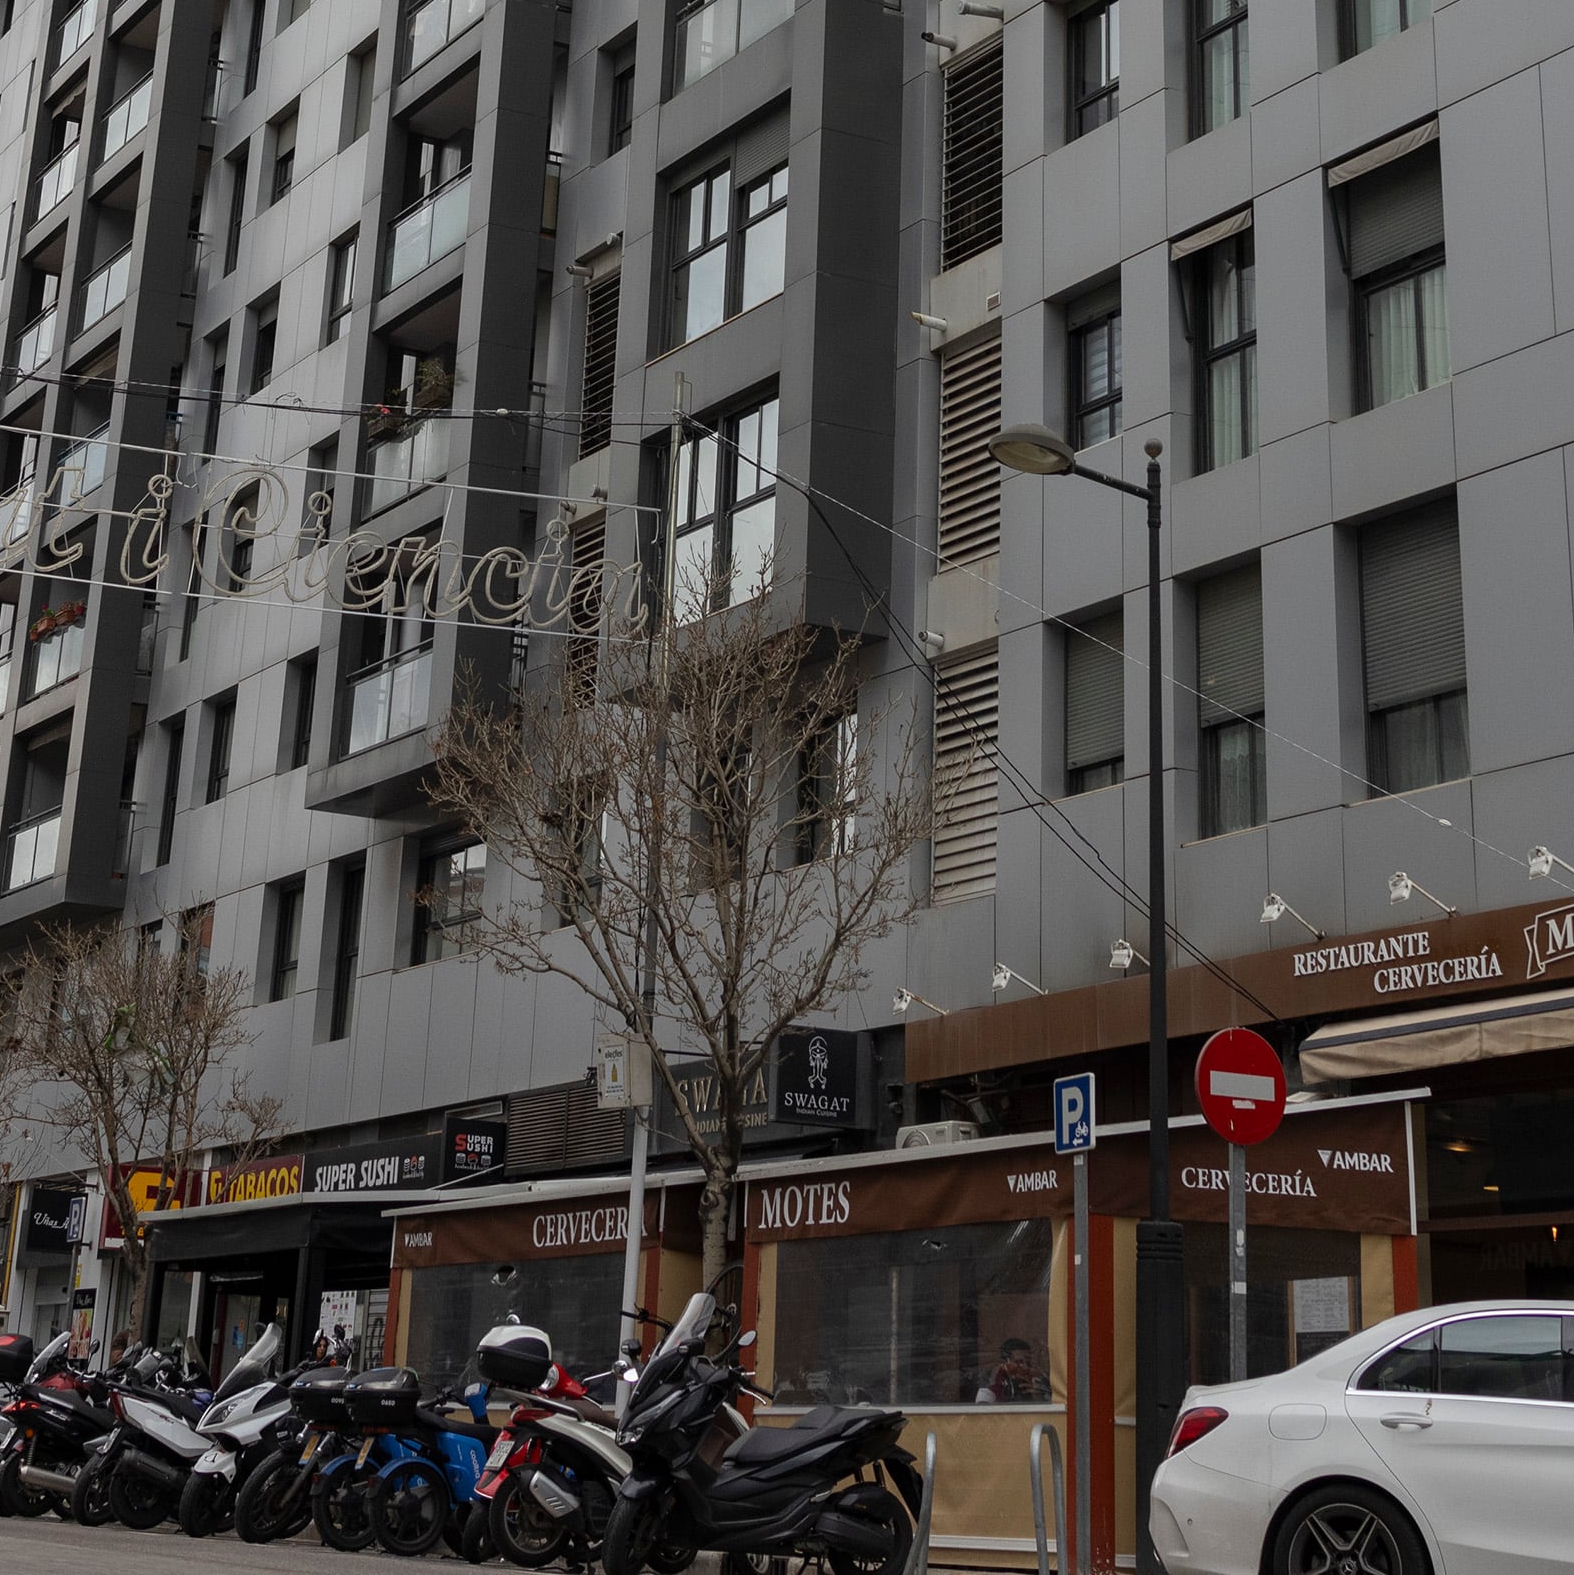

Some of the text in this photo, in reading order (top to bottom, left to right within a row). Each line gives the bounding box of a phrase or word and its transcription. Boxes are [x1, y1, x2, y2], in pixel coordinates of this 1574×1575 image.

[1292, 930, 1431, 978] RESTAURANTE
[1372, 945, 1504, 994] CERVECERÍA
[784, 1091, 850, 1112] SWAGAT
[1061, 1086, 1085, 1146] P
[313, 1156, 400, 1193] SUPER SUSHI
[1333, 1150, 1395, 1174] AMBAR
[228, 1165, 300, 1203] TABACOS
[1016, 1169, 1059, 1194] AMBAR
[758, 1181, 851, 1229] MOTES
[409, 1232, 433, 1248] AMBAR
